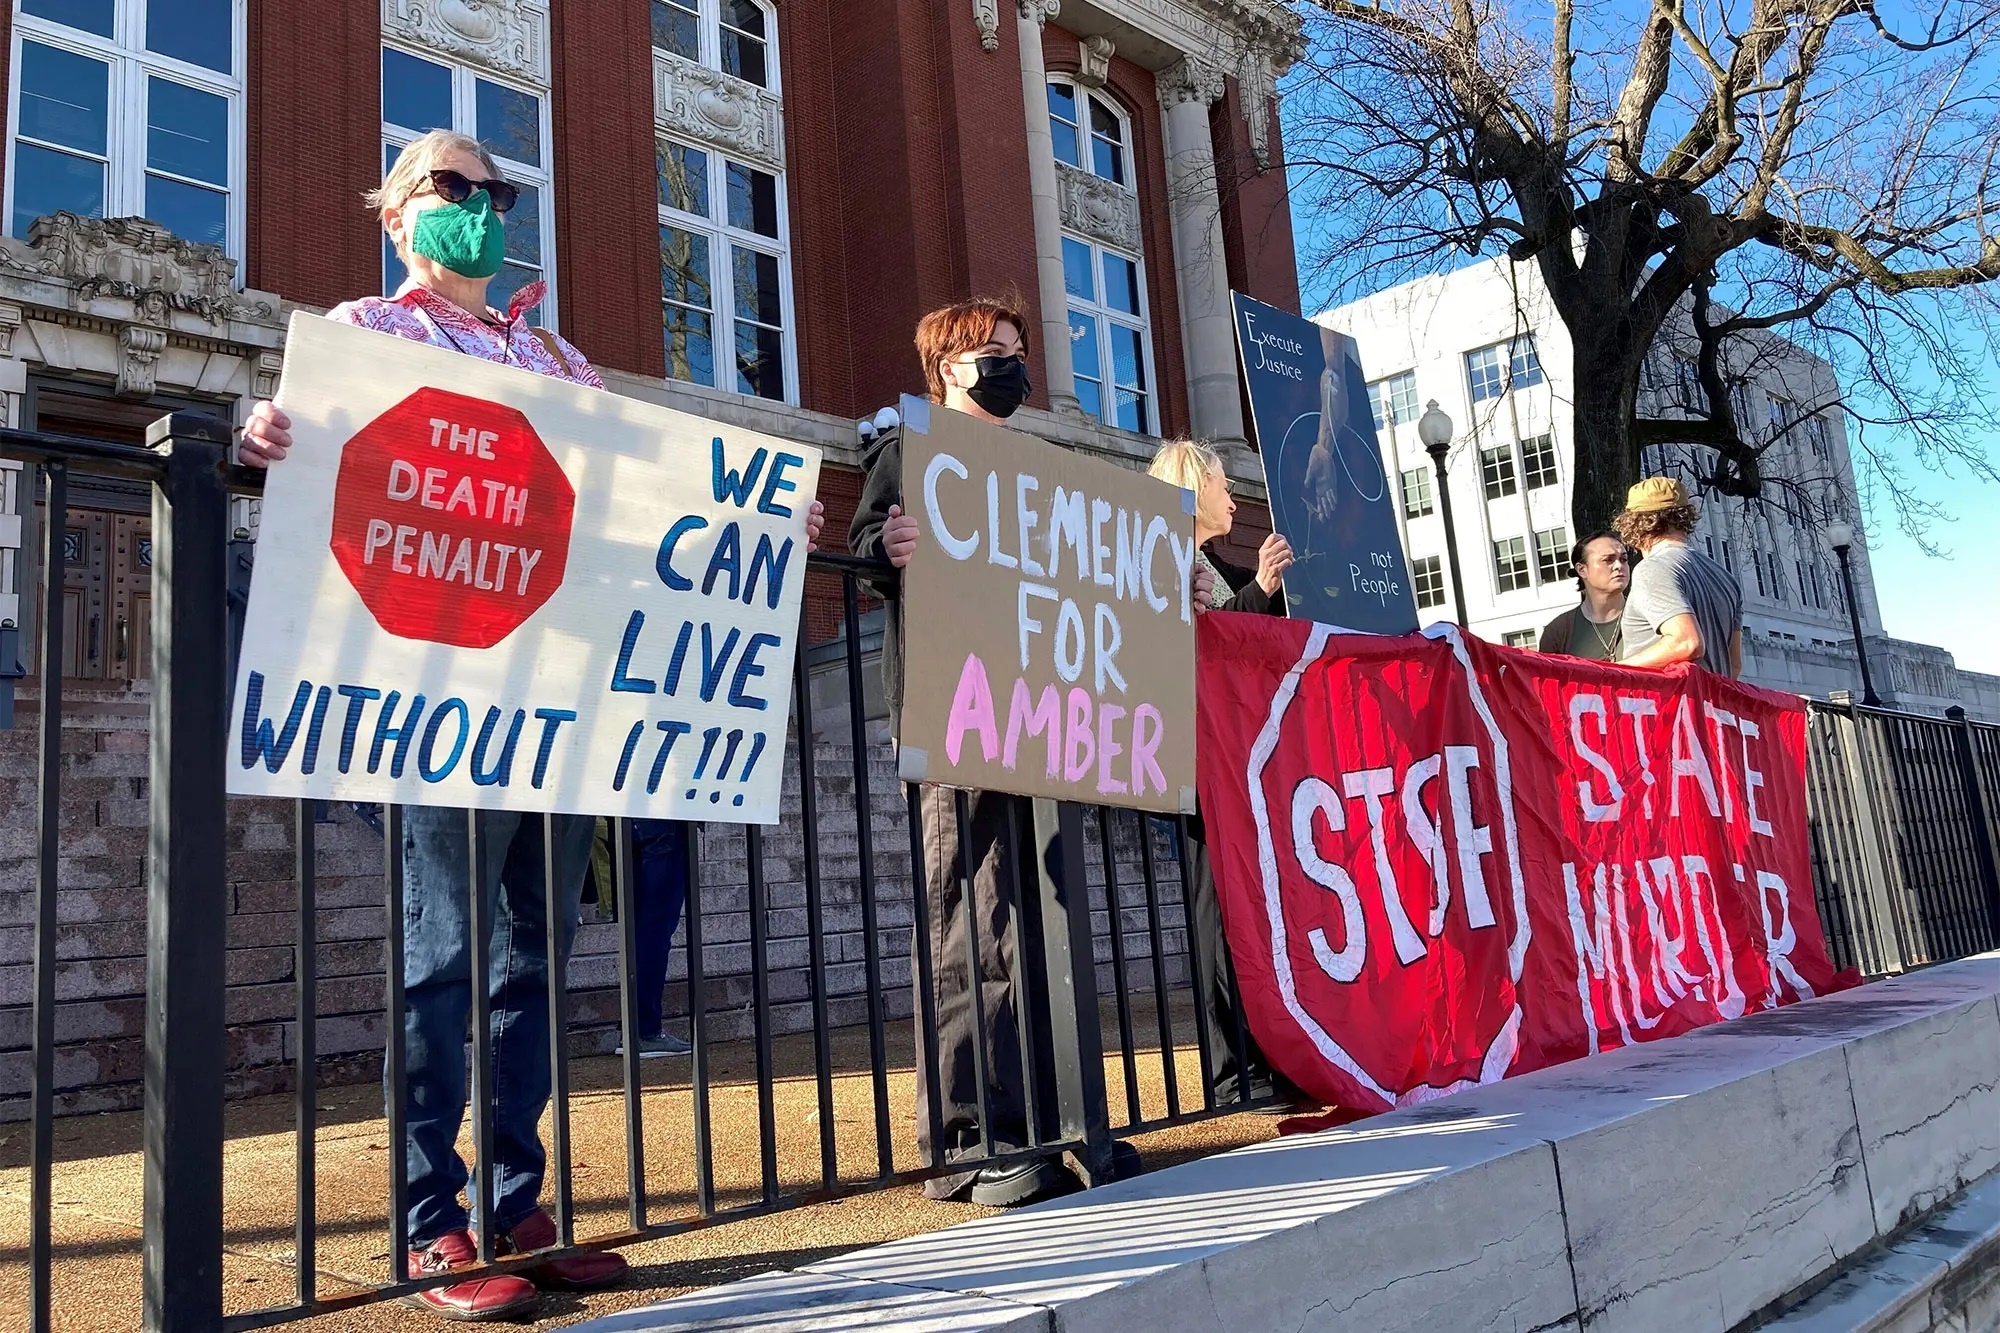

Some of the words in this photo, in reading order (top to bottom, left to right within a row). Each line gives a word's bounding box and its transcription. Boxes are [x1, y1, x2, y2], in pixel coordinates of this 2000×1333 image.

[1244, 311, 1303, 355] Execute
[1255, 339, 1303, 380] Justice
[429, 417, 499, 462] THE
[712, 437, 803, 518] WE
[387, 459, 529, 527] DEATH
[363, 519, 542, 596] PENALTY
[655, 514, 795, 610] CAN
[923, 452, 1193, 626] CLEMENCY
[1370, 551, 1393, 568] not
[1349, 563, 1399, 608] People
[610, 609, 781, 711] LIVE
[1018, 580, 1128, 696] FOR
[241, 670, 577, 789] WITHOUT
[612, 719, 766, 807] IT!!!
[945, 652, 1168, 797] AMBER
[1569, 693, 1774, 838] STATE
[1562, 855, 1816, 1056] MURDR
